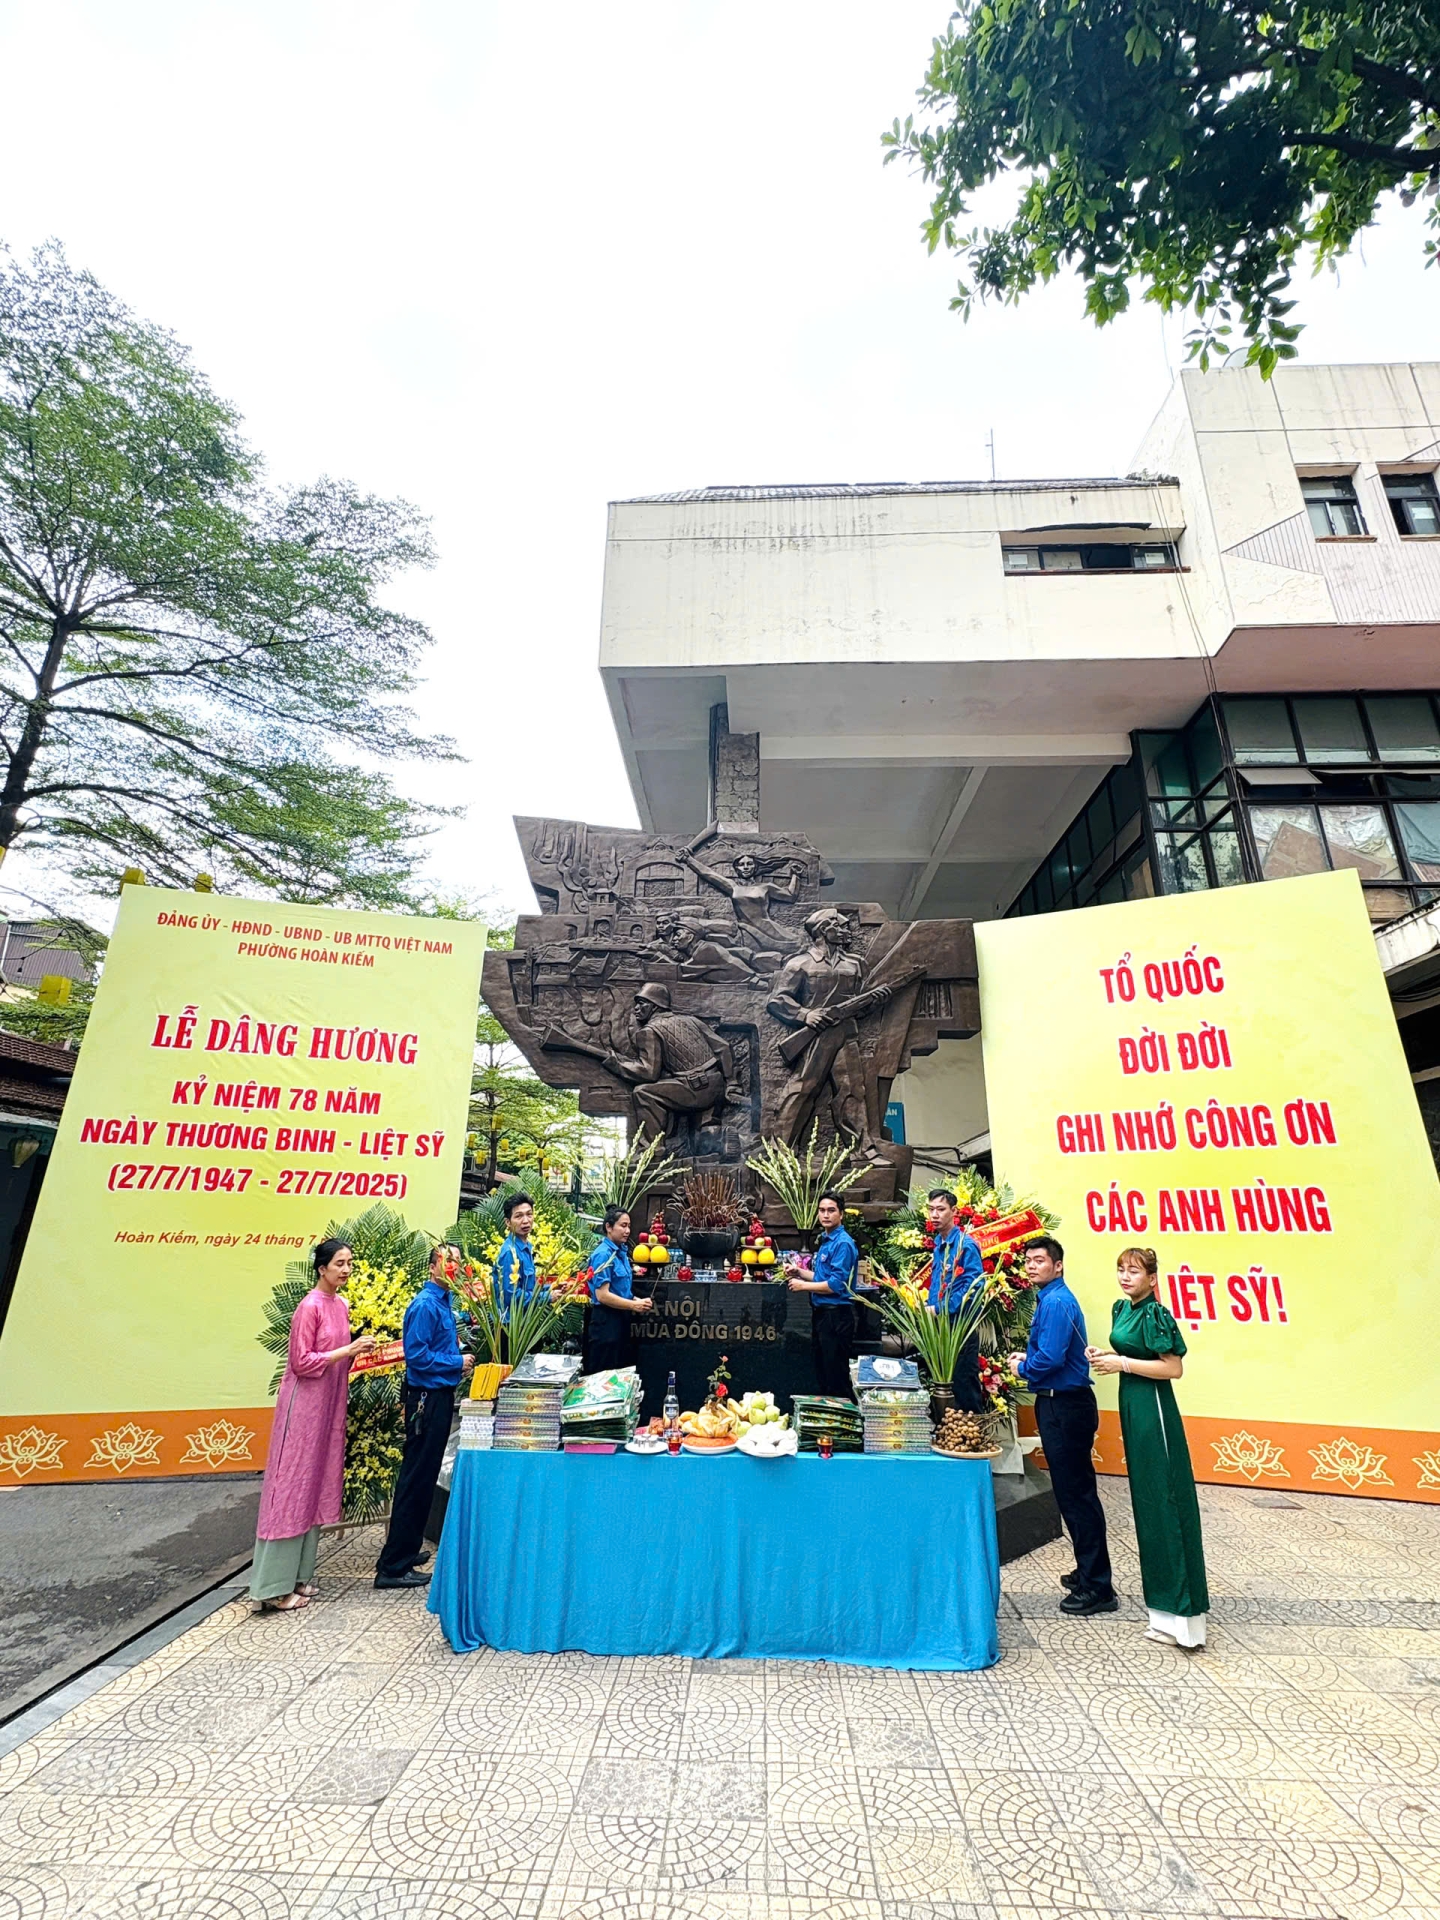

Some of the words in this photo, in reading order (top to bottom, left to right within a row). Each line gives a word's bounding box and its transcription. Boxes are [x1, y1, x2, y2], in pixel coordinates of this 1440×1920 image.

[158, 910, 198, 929] ĐẢNG
[201, 916, 221, 930] ỦY
[231, 921, 273, 936] HĐND
[283, 926, 323, 942] UBND
[333, 931, 353, 945] UB
[355, 933, 392, 950] MTTQ
[394, 937, 421, 954] VIỆT
[423, 940, 453, 954] NAM
[237, 941, 299, 960] PHƯỜNG
[301, 947, 338, 964] HOÀN
[342, 950, 375, 967] KIẾM
[1099, 951, 1136, 1003] TỔ
[1143, 945, 1225, 1003] QUỐC
[151, 1004, 200, 1048] LỄ
[205, 1014, 298, 1057] DÂNG
[308, 1026, 418, 1065] HƯƠNG
[1118, 1027, 1171, 1075] ĐỜI
[1176, 1021, 1232, 1071] ĐỜI
[172, 1074, 208, 1105] KỶ
[213, 1082, 281, 1113] NIỆM
[289, 1088, 318, 1112] 78
[324, 1086, 381, 1115] NĂM
[80, 1115, 158, 1146] NGÀY
[166, 1122, 269, 1151] THƯƠNG
[275, 1127, 336, 1153] BINH
[359, 1127, 409, 1161] LIỆT
[414, 1129, 445, 1158] SỸ
[1056, 1113, 1106, 1154] GHI
[1112, 1101, 1177, 1152] NHỚ
[1185, 1099, 1277, 1149] CÔNG
[1283, 1098, 1337, 1146] ƠN
[107, 1163, 253, 1193] (27/7/1947
[276, 1169, 408, 1199] 27/7/2025)
[1086, 1182, 1148, 1233] CÁC
[1159, 1189, 1226, 1232] ANH
[1231, 1179, 1332, 1233] HÙNG
[114, 1231, 156, 1243] Hoàn
[157, 1231, 200, 1246] Kiếm,
[204, 1234, 241, 1248] ngày
[244, 1233, 262, 1245] 24
[263, 1234, 305, 1249] tháng
[309, 1233, 318, 1244] 7
[664, 1295, 701, 1321] NỘI
[1154, 1265, 1217, 1331] IỆT
[1227, 1266, 1287, 1323] SỸ!
[630, 1317, 671, 1339] MÙA
[674, 1320, 729, 1340] ĐÔNG
[734, 1325, 777, 1341] 1946
